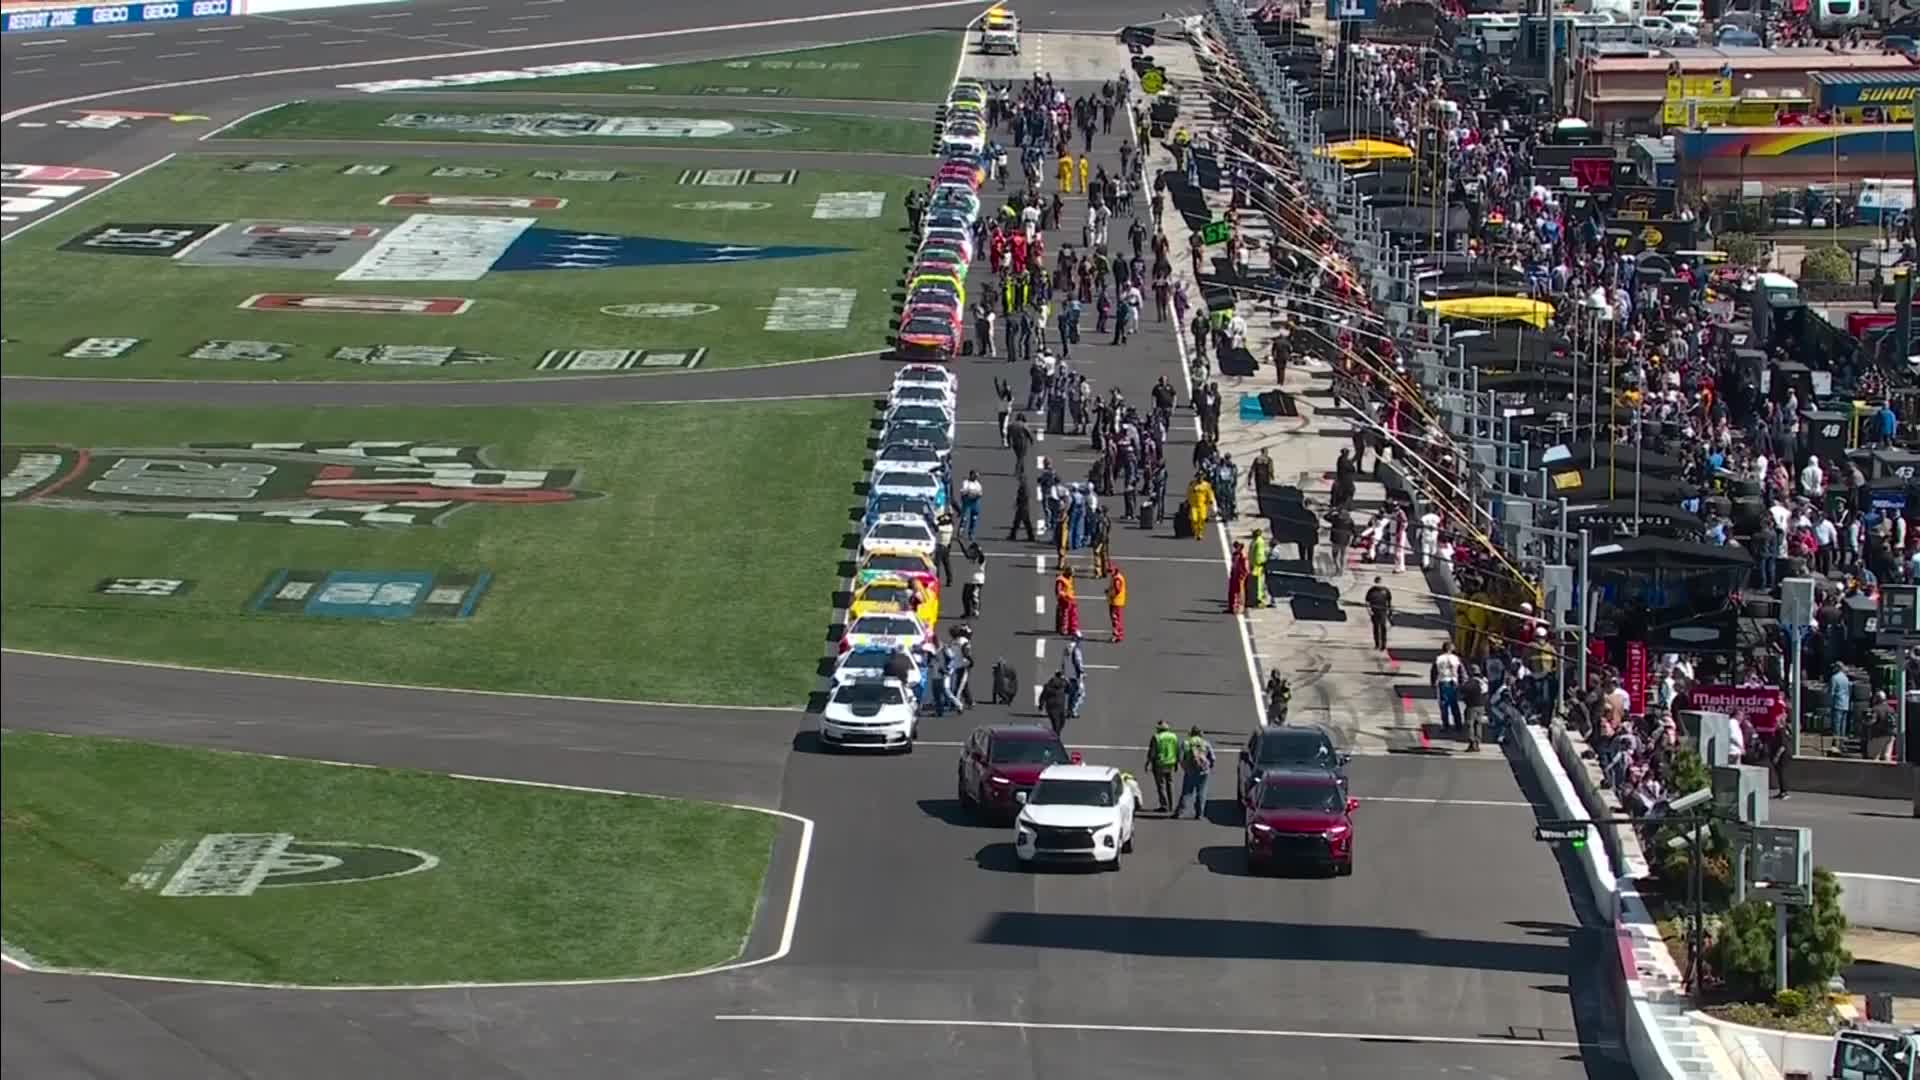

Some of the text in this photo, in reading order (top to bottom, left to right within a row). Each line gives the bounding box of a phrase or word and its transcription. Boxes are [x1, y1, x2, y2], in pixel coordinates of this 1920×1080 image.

[92, 7, 129, 23] GEICO
[143, 3, 179, 20] GEICO
[192, 0, 227, 16] GEICO
[8, 10, 77, 30] RESTART ZONE
[1822, 424, 1840, 437] 48
[1895, 466, 1914, 479] 43
[1693, 693, 1775, 706] Mahindra
